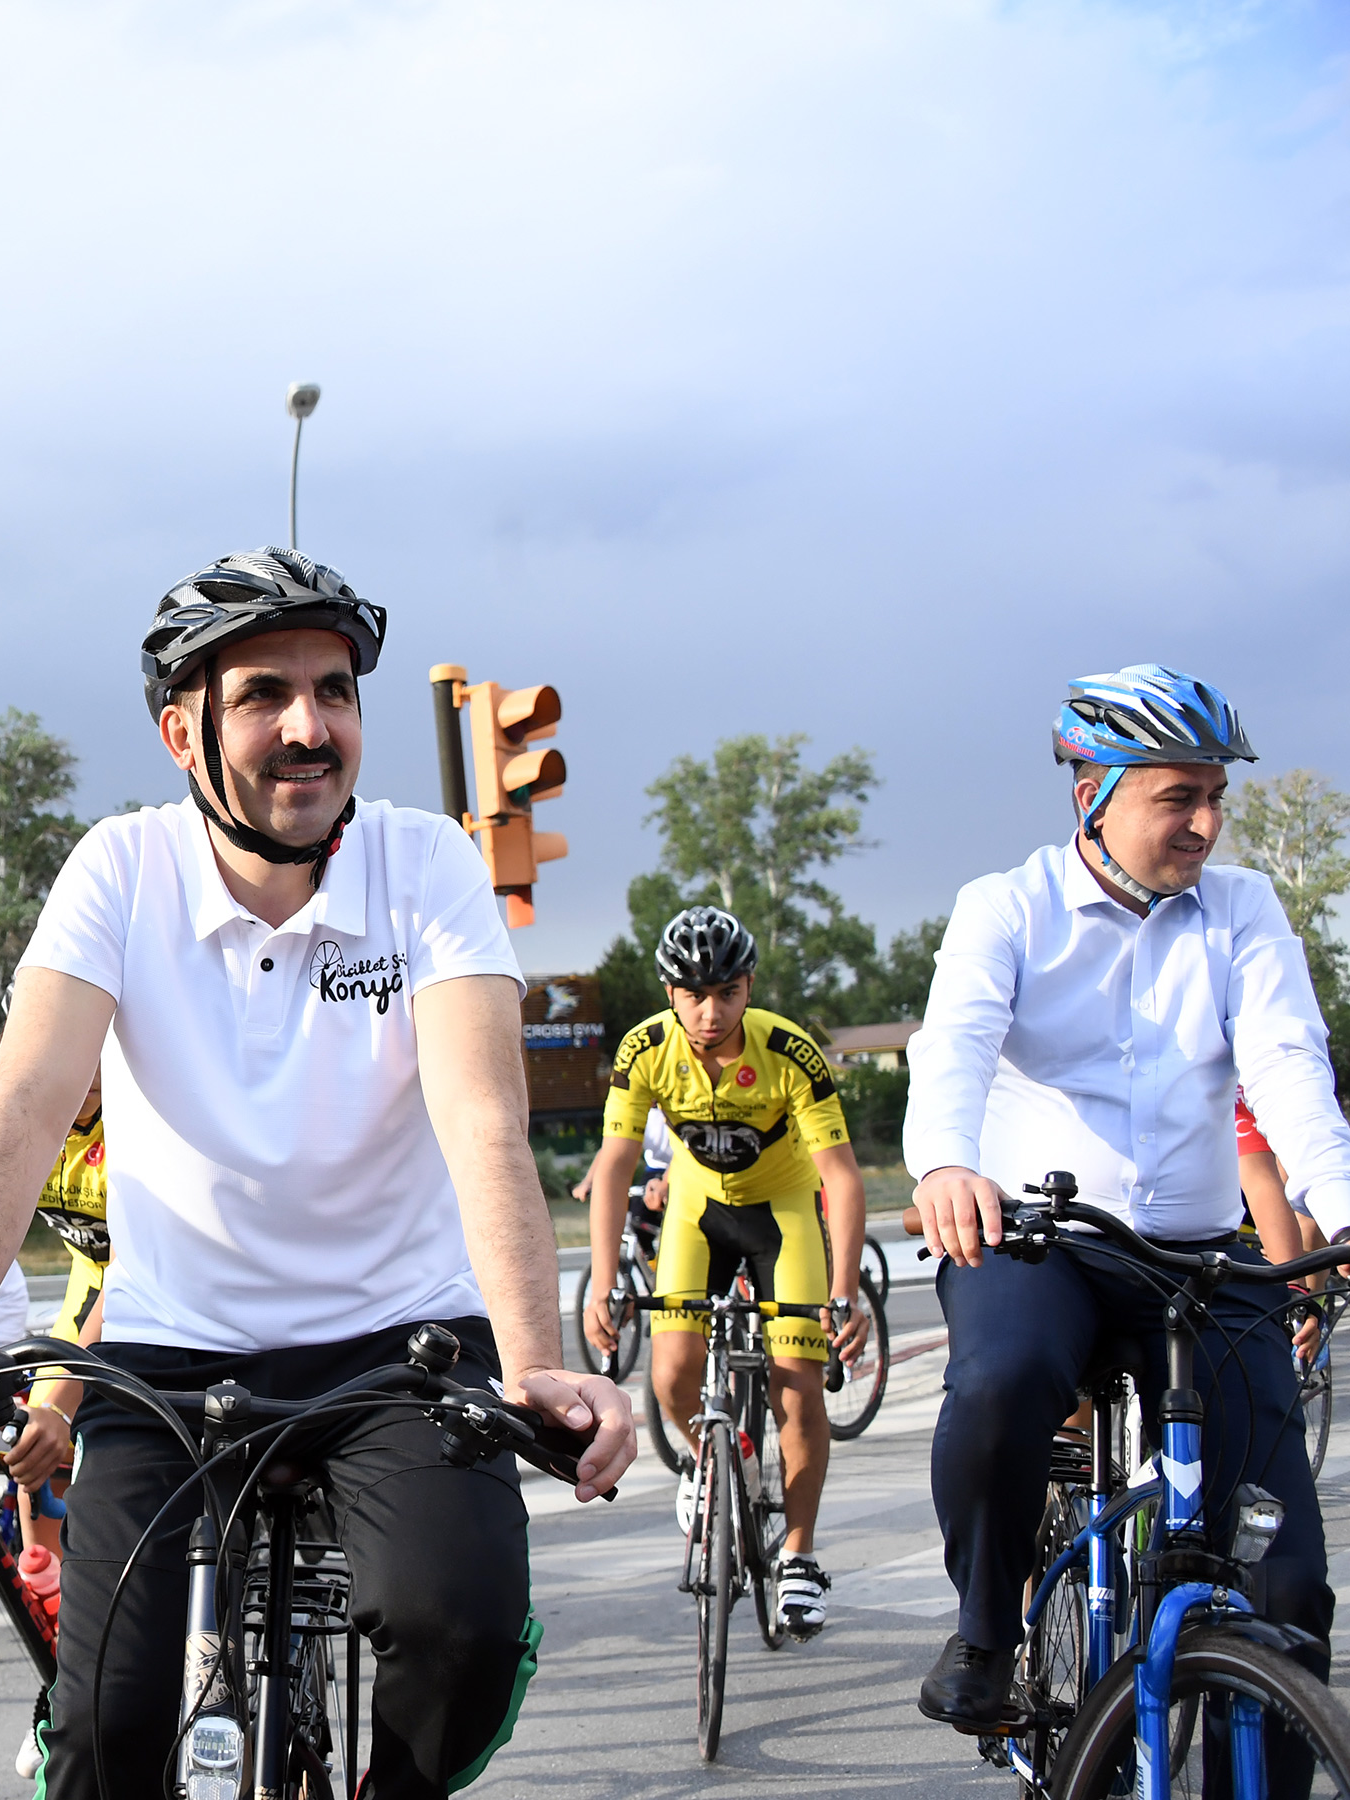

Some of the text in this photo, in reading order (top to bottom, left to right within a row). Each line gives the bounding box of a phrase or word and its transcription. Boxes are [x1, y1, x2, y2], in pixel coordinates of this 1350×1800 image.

[319, 968, 403, 1016] Konya
[612, 1027, 651, 1073] KBBS
[784, 1035, 828, 1083] KBBS
[768, 1334, 828, 1349] KONYA
